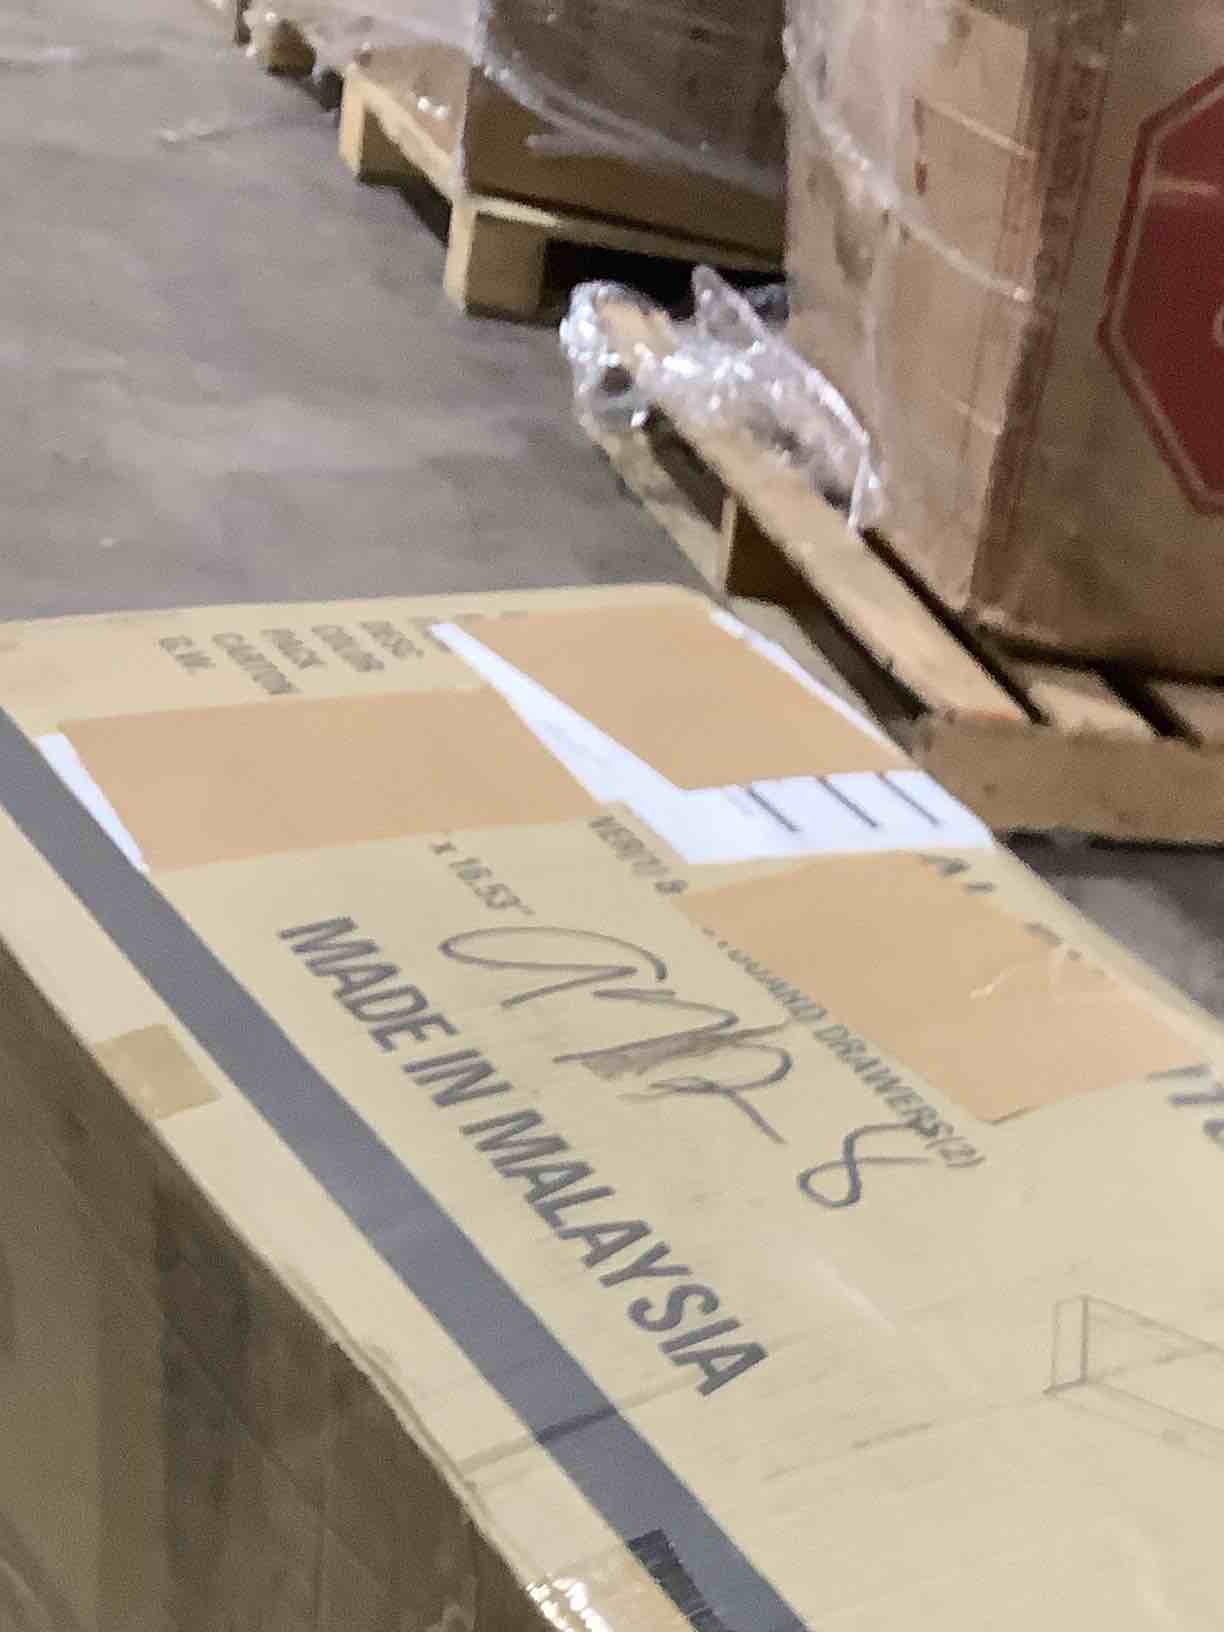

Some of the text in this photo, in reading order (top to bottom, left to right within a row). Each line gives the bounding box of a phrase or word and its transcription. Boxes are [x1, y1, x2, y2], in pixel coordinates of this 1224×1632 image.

[278, 915, 461, 1053] MADE
[402, 1048, 512, 1107] IN
[459, 1109, 768, 1397] MALAYSIA
